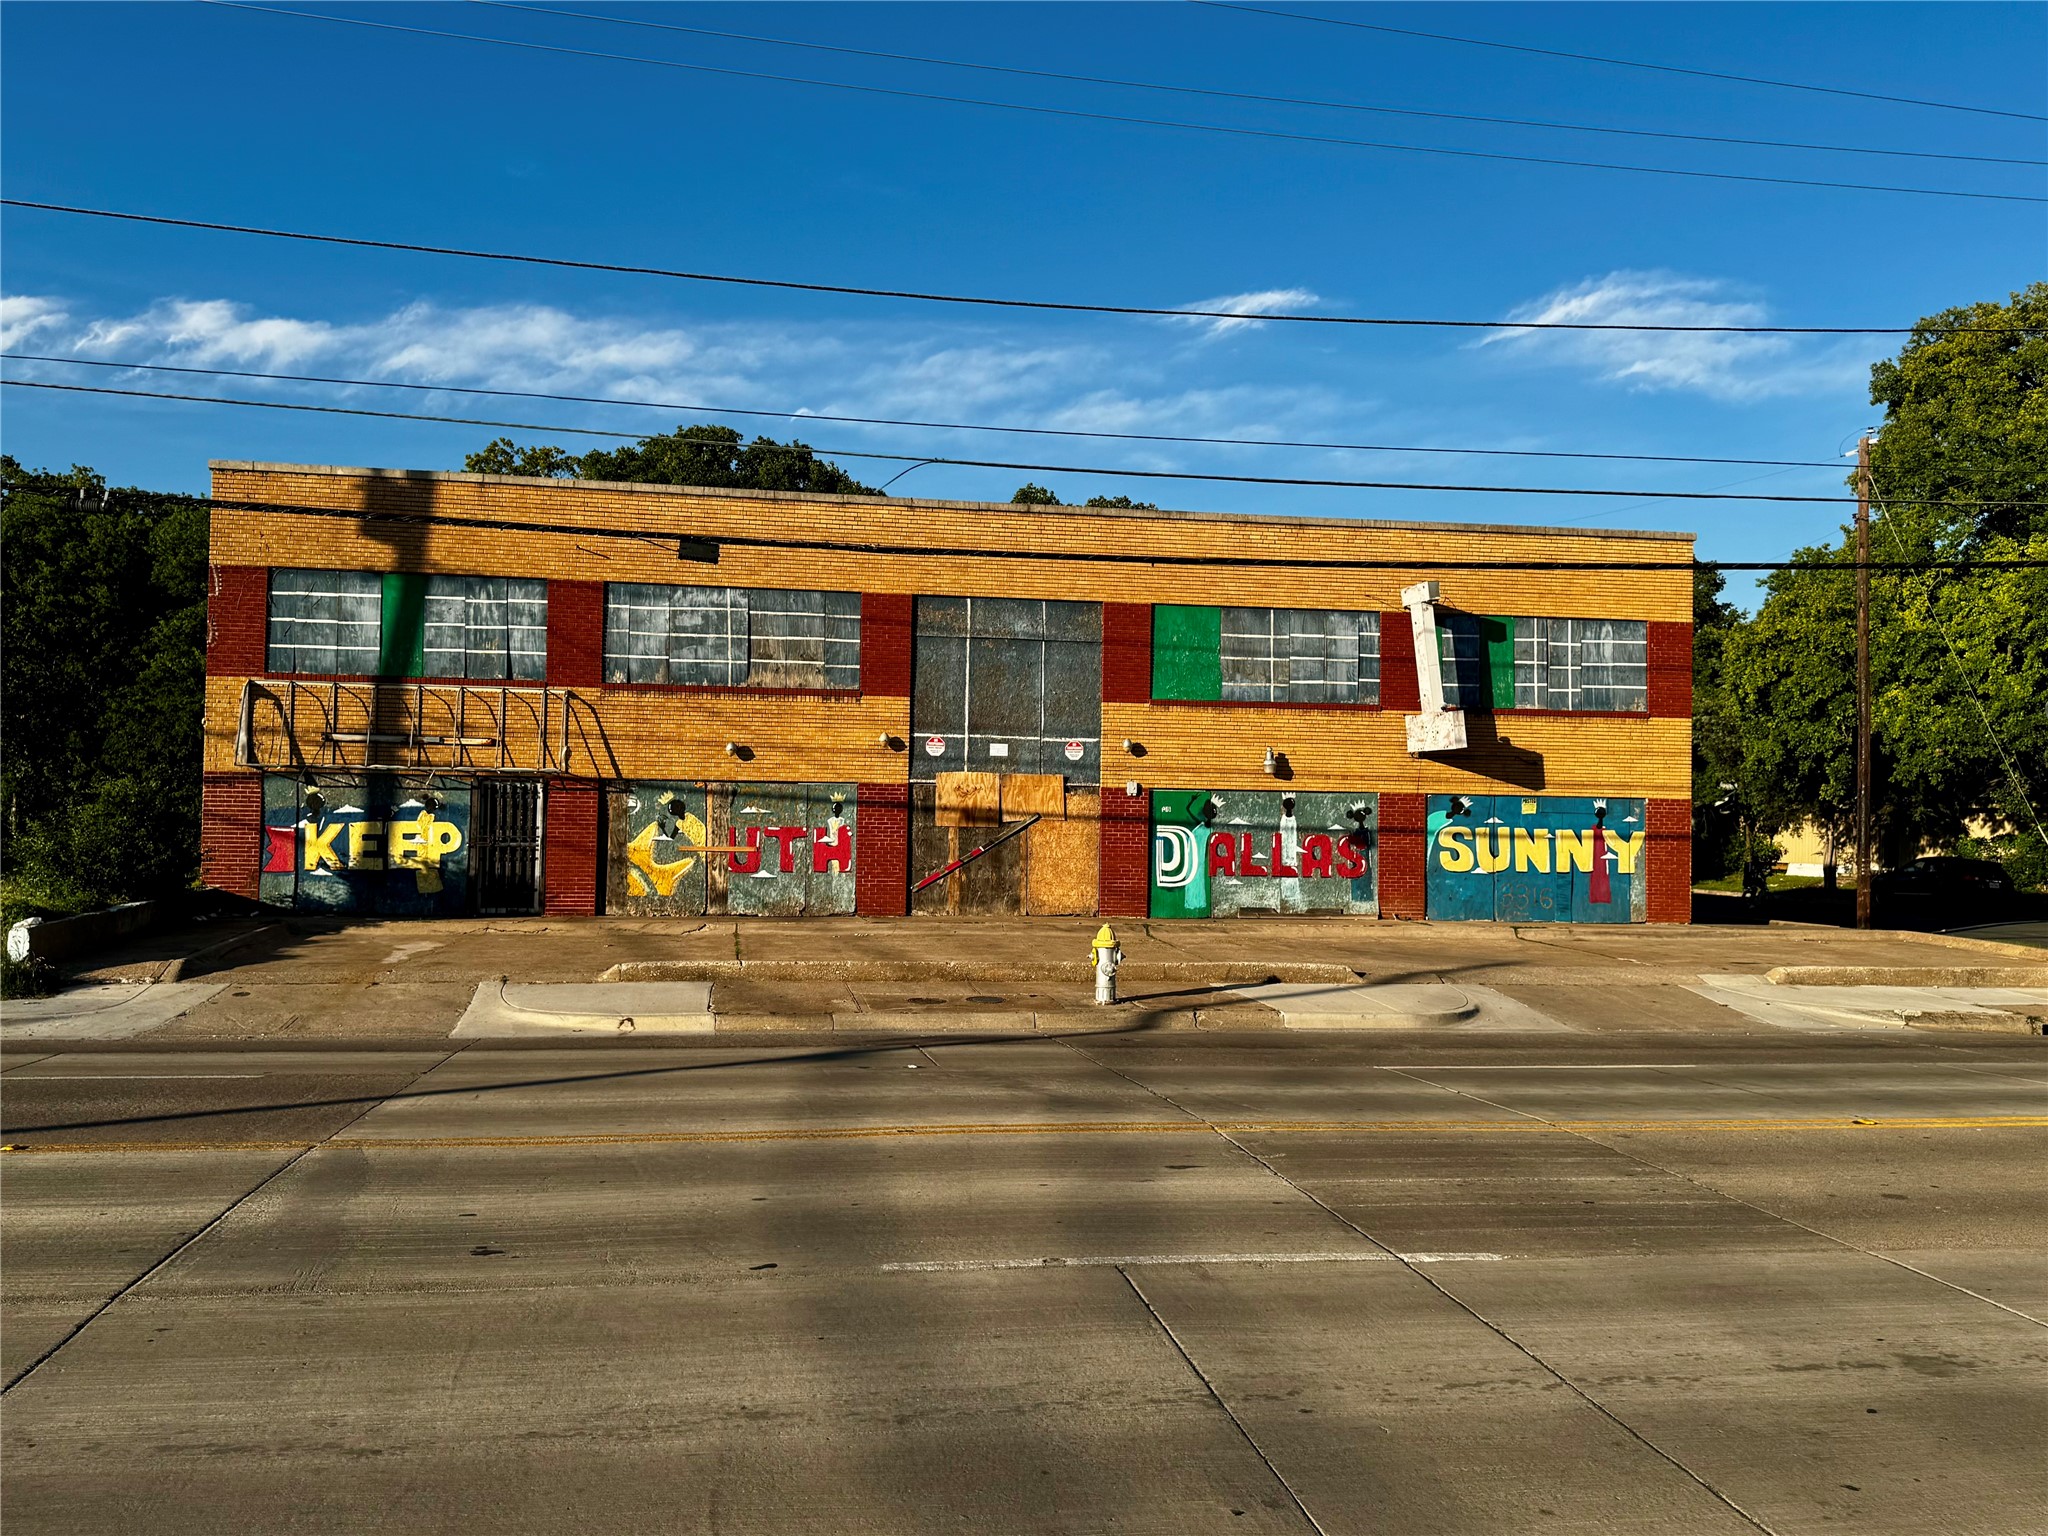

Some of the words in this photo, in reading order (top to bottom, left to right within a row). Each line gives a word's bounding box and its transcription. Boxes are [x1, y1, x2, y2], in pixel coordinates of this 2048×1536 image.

[304, 821, 463, 871] KEEP
[1156, 825, 1368, 887] DALLAS
[1438, 826, 1646, 874] SUNNY
